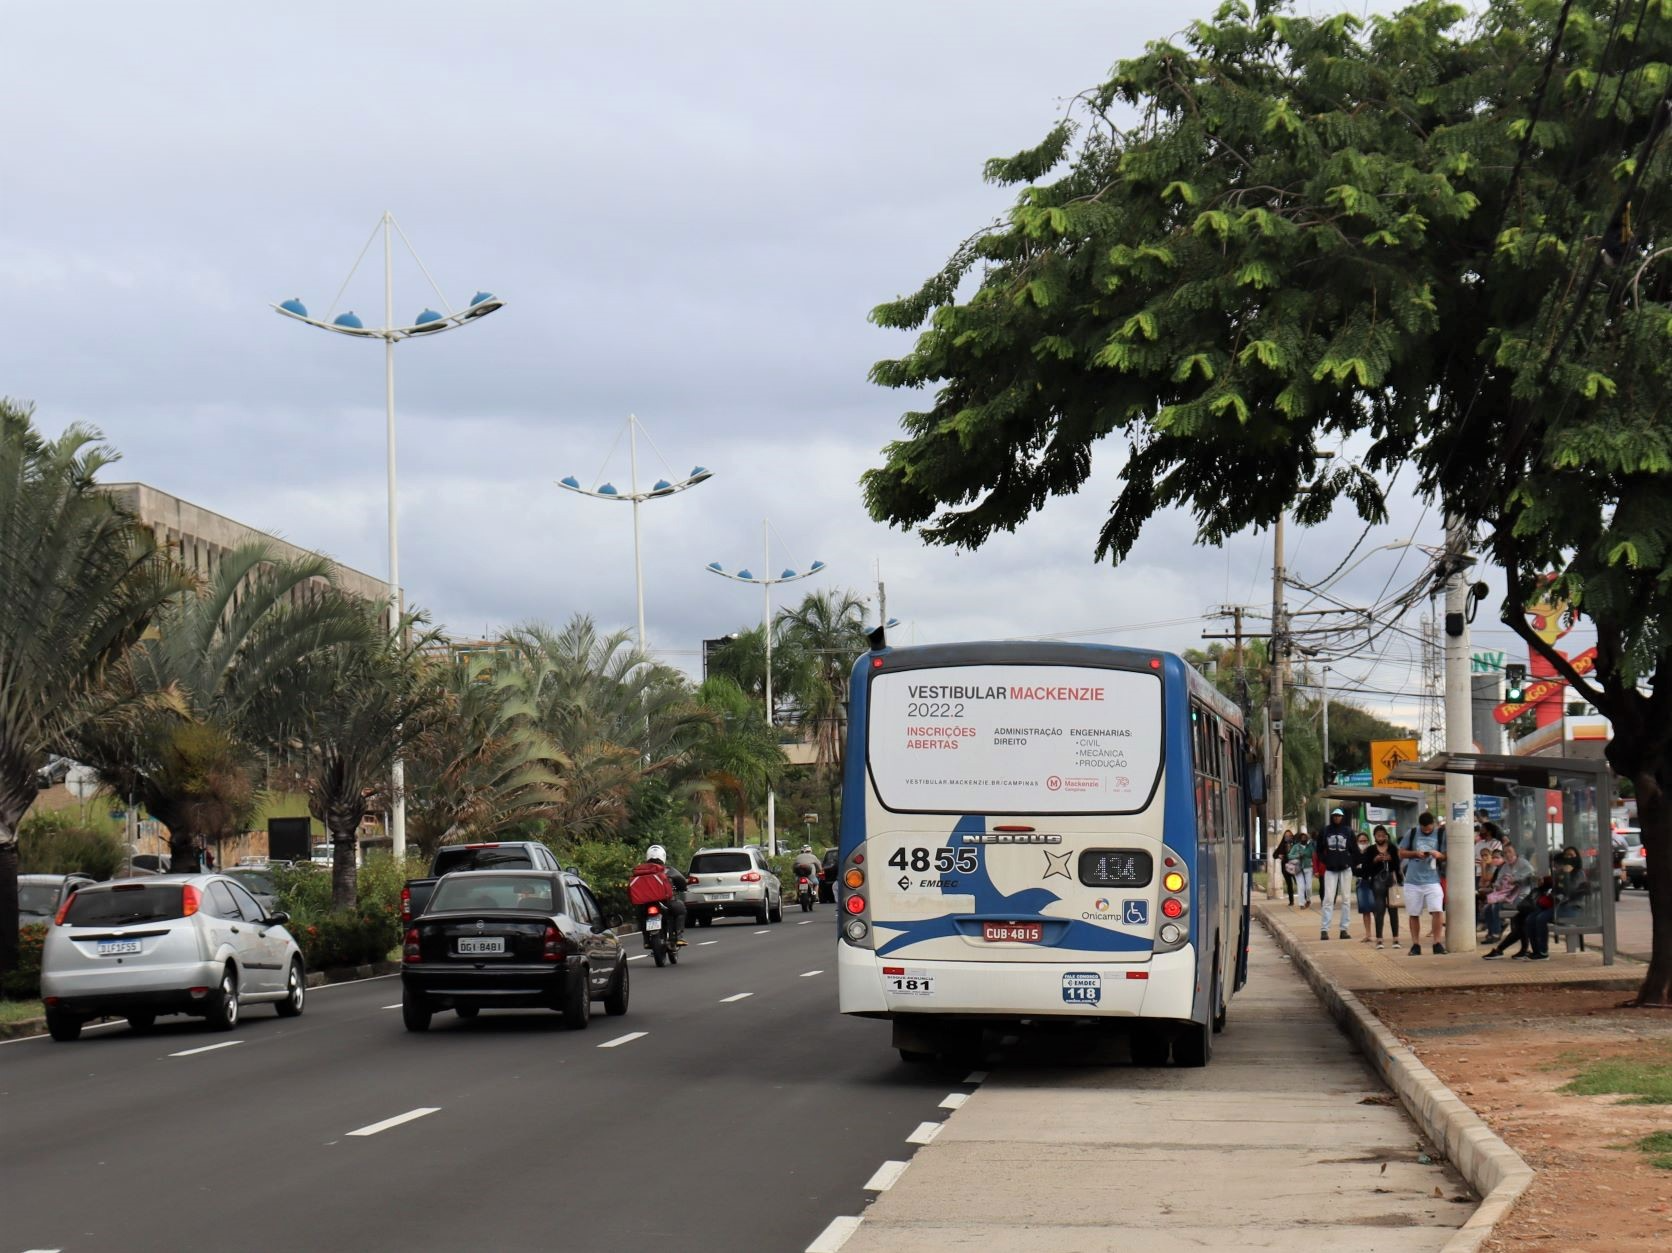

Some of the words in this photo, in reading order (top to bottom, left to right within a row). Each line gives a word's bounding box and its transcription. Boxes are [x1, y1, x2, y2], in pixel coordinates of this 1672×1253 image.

[908, 685, 1007, 700] VESTIBULAR
[1010, 687, 1105, 701] MACKENZIE
[907, 703, 965, 717] 2022.2
[907, 726, 976, 739] INSCRIÇÕES
[994, 727, 1063, 737] ADMINISTRAÇÃO
[1070, 728, 1133, 737] ENGENHARIAS:
[907, 740, 959, 750] ABERTAS
[994, 737, 1027, 746] DIREITO
[1080, 739, 1101, 747] CIVIL
[1079, 748, 1124, 758] MECÂNICA
[1079, 759, 1128, 769] PRODUÇÃO
[1064, 780, 1099, 788] Mackenzie
[888, 847, 979, 874] 4855
[1093, 857, 1137, 880] 434
[920, 879, 959, 888] EMDEC
[1082, 911, 1122, 922] Onicamp
[893, 979, 930, 991] 181
[1067, 988, 1096, 999] 118
